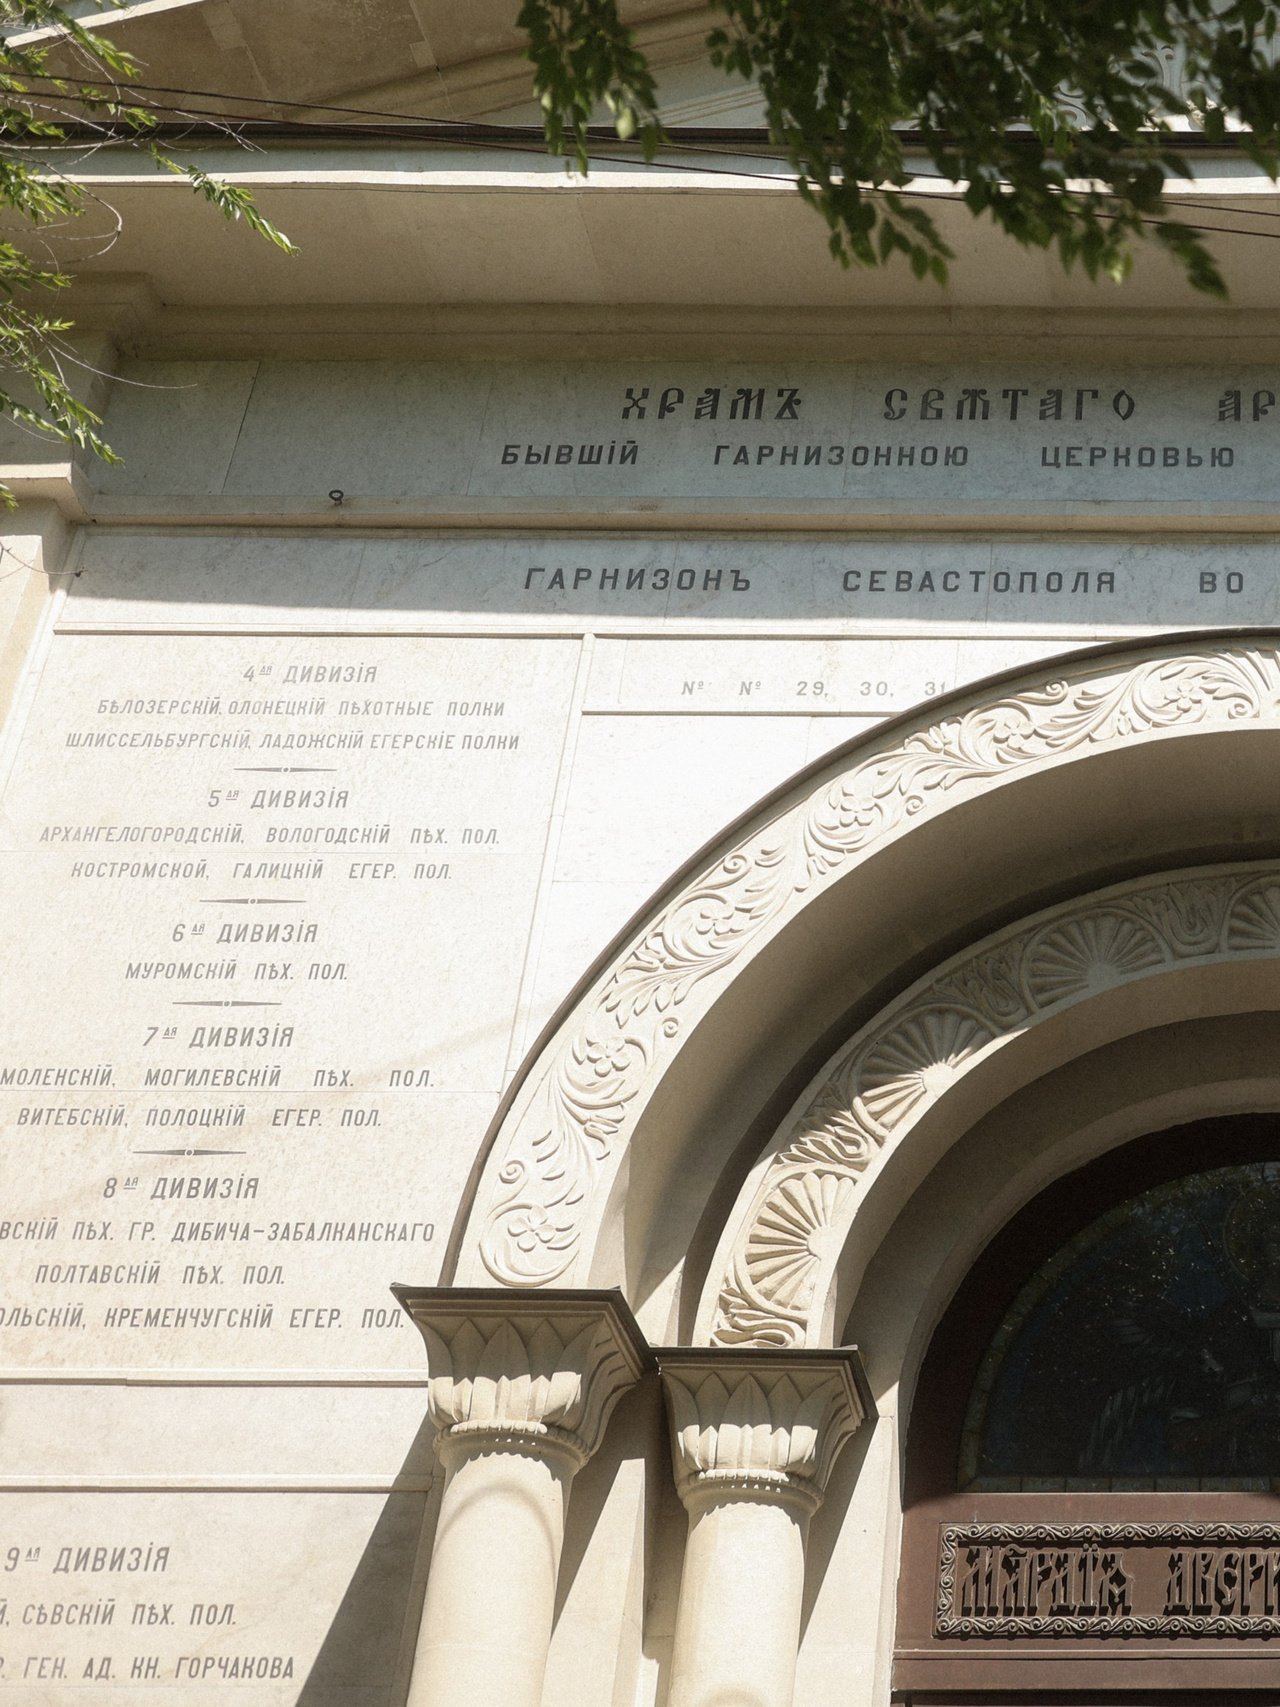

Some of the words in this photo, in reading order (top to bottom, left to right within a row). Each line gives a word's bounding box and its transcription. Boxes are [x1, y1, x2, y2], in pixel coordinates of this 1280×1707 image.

[622, 388, 801, 420] ХРАМЪ
[714, 445, 968, 466] ГАРНИЗОННОЮ
[1042, 447, 1234, 468] ЦЕРКОВЬЮ
[525, 568, 750, 591] ГАРНИЗОНЪ
[843, 571, 1115, 593] СЕВАСТОПОЛЯ
[1200, 572, 1243, 593] ВО
[796, 681, 828, 697] 29,
[860, 681, 893, 697] 30,
[447, 702, 504, 716] ПОЛКИ
[462, 735, 519, 749] ПОЛКИ
[462, 828, 499, 844] ПОЛ.
[71, 859, 209, 879] КОСТРОМСКОЙ,
[349, 863, 395, 879] ЕГЕР.
[414, 864, 450, 879] ПОЛ.
[308, 963, 347, 980] ПОЛ.
[389, 1070, 433, 1087] ПОЛ.
[272, 1109, 321, 1126] ЕГЕР.
[341, 1109, 381, 1126] ПОЛ.
[129, 1222, 155, 1240] ГР.
[171, 1222, 434, 1242] ДИБИЧА-ЗАБАЛКАНСКАГО
[243, 1266, 284, 1284] ПОЛ.
[290, 1309, 341, 1328] ЕГЕР.
[361, 1309, 404, 1327] ПОЛ.
[190, 1604, 235, 1625] ПОЛ.
[24, 1657, 67, 1678] ГЕН.
[83, 1657, 115, 1680] АД.
[131, 1657, 160, 1679] КН.
[175, 1657, 293, 1678] ГОРЧАКОВА
